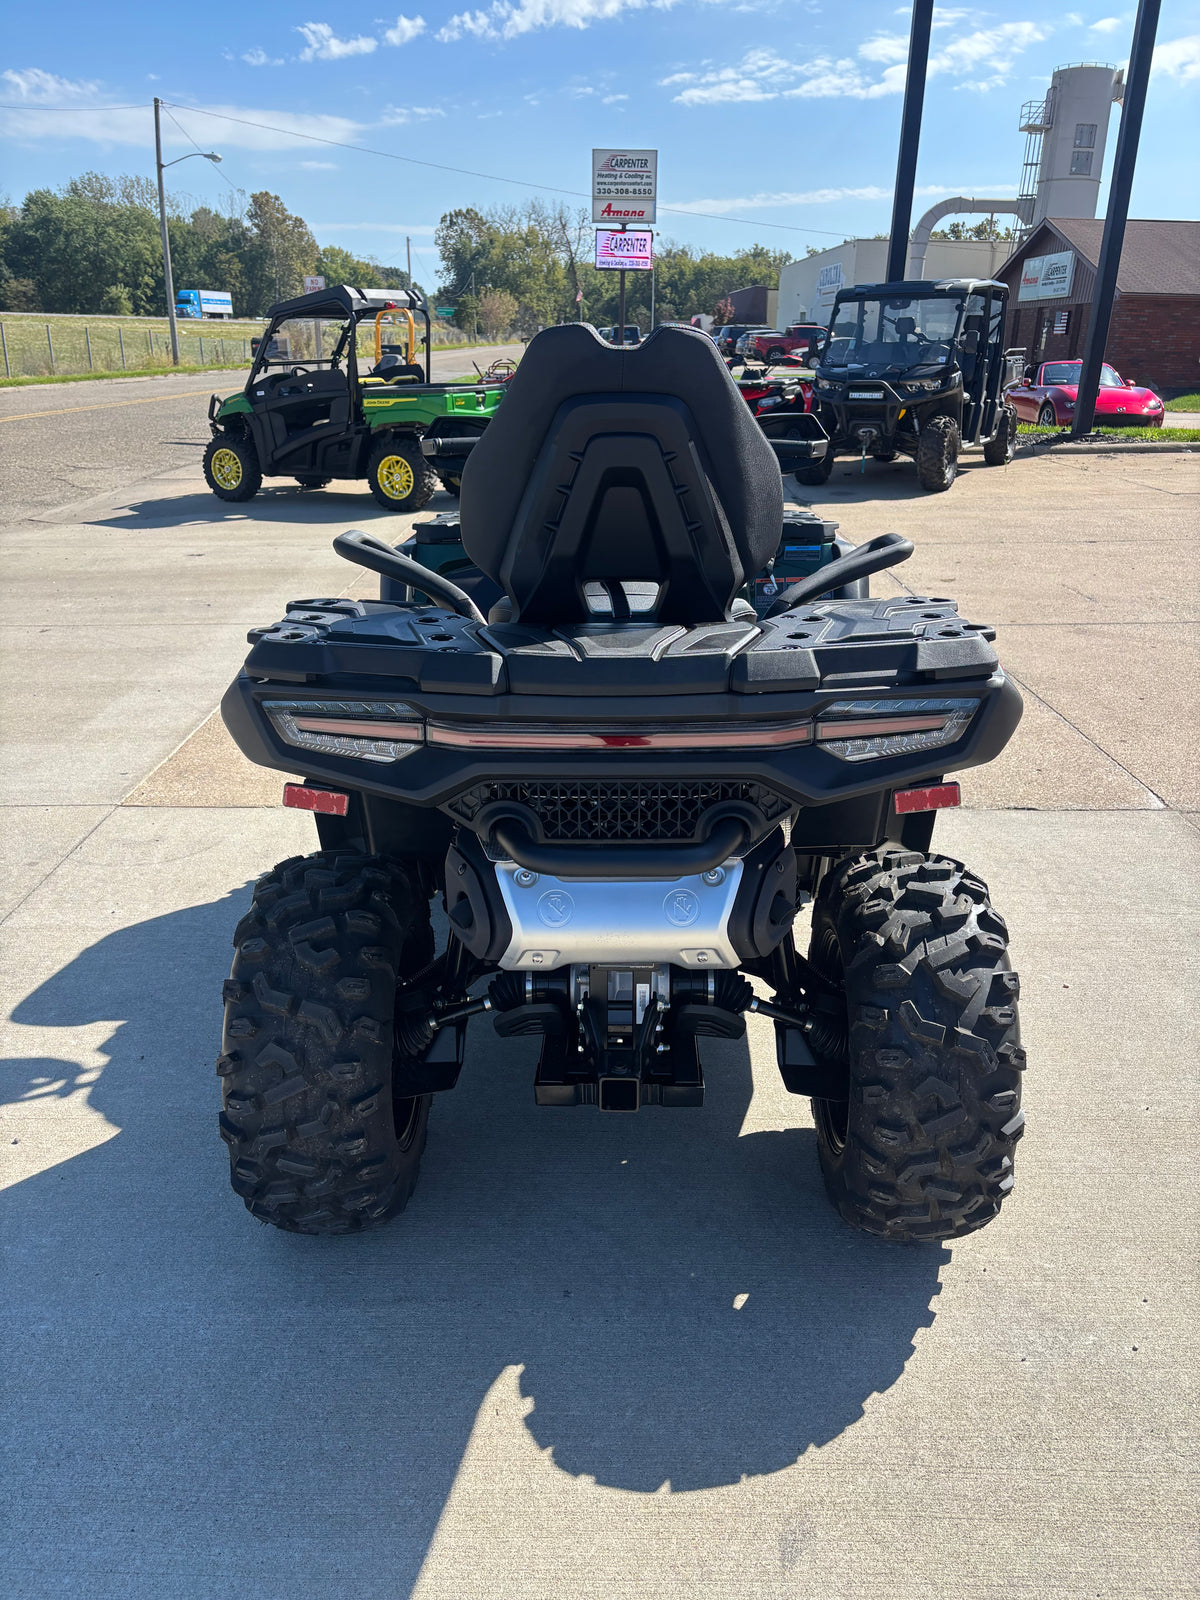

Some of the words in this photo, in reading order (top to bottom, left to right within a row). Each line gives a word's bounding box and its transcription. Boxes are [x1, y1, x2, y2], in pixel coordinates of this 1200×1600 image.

[610, 158, 649, 168] CARPENTER
[596, 172, 618, 180] Heating
[624, 172, 644, 180] Cooling
[600, 202, 646, 217] Amana
[610, 236, 648, 252] CARPENTER
